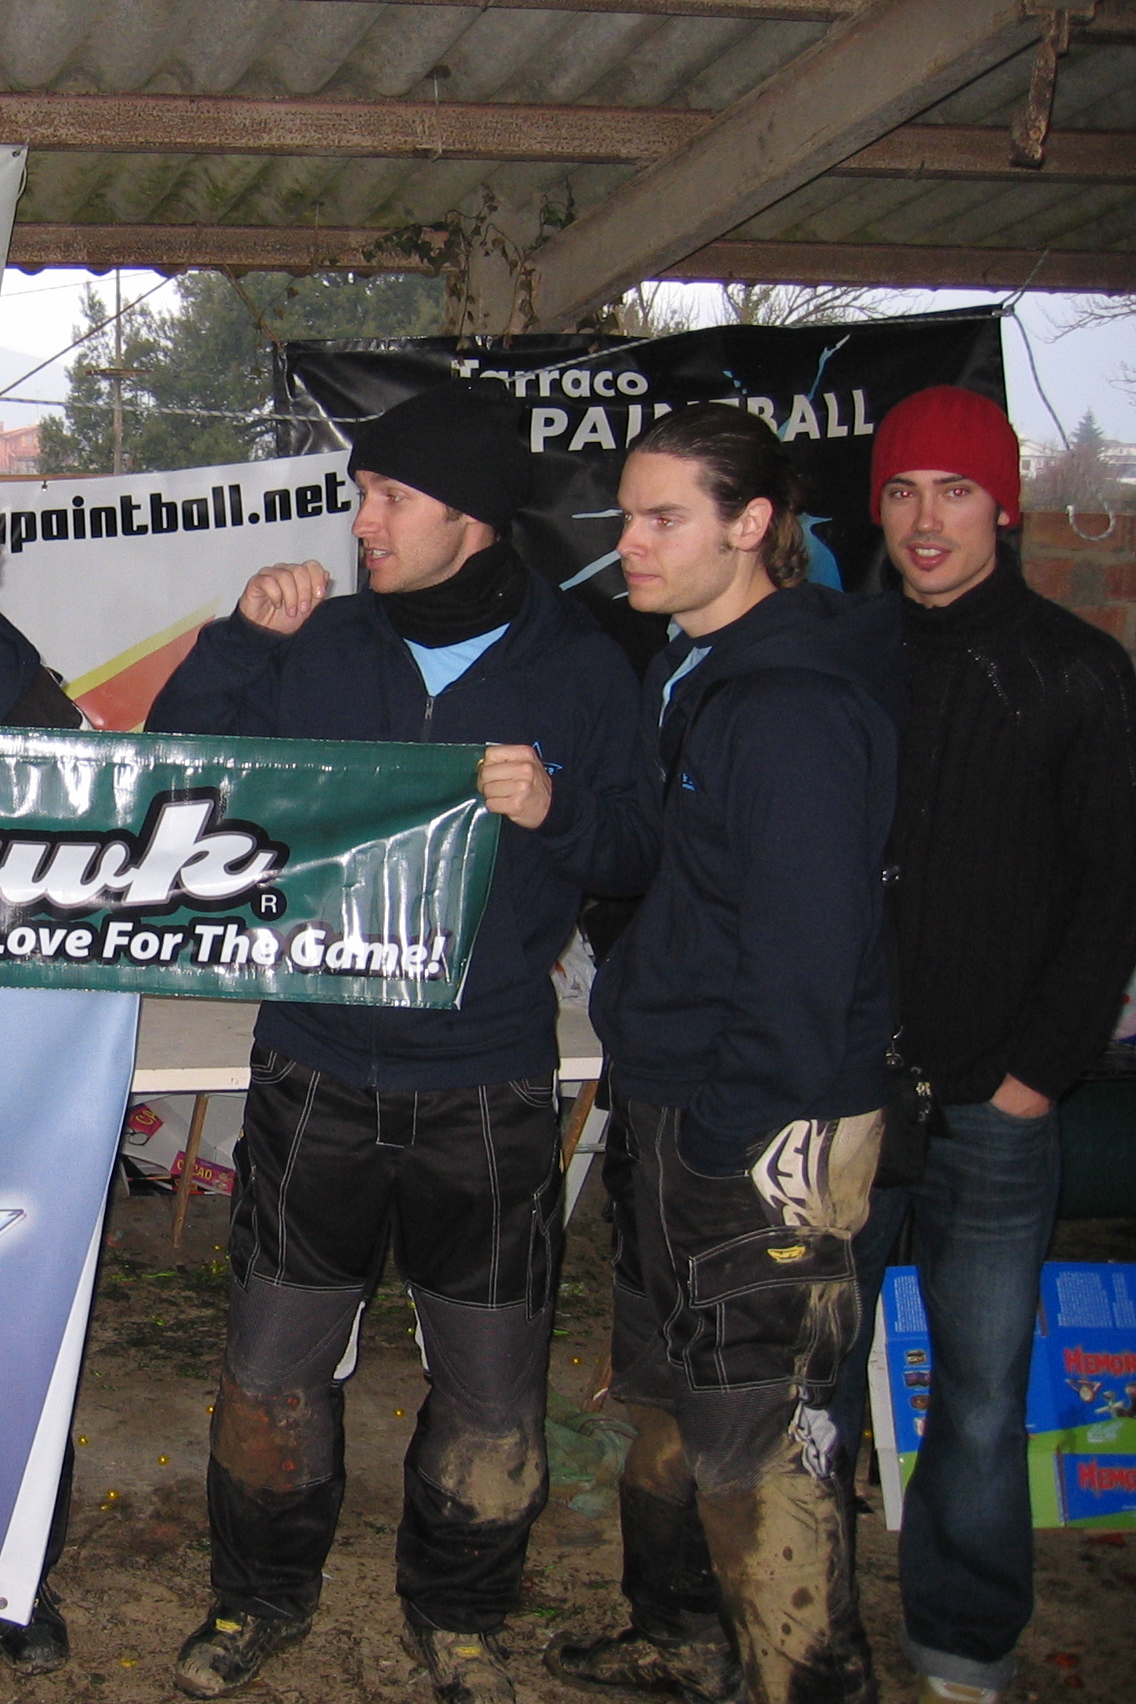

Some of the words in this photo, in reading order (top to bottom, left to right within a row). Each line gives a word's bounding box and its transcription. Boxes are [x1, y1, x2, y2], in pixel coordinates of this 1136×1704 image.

[451, 359, 649, 398] Trraco
[530, 389, 874, 453] PAIBALL
[102, 921, 182, 960] For
[194, 923, 279, 965] The
[290, 928, 447, 974] Game!
